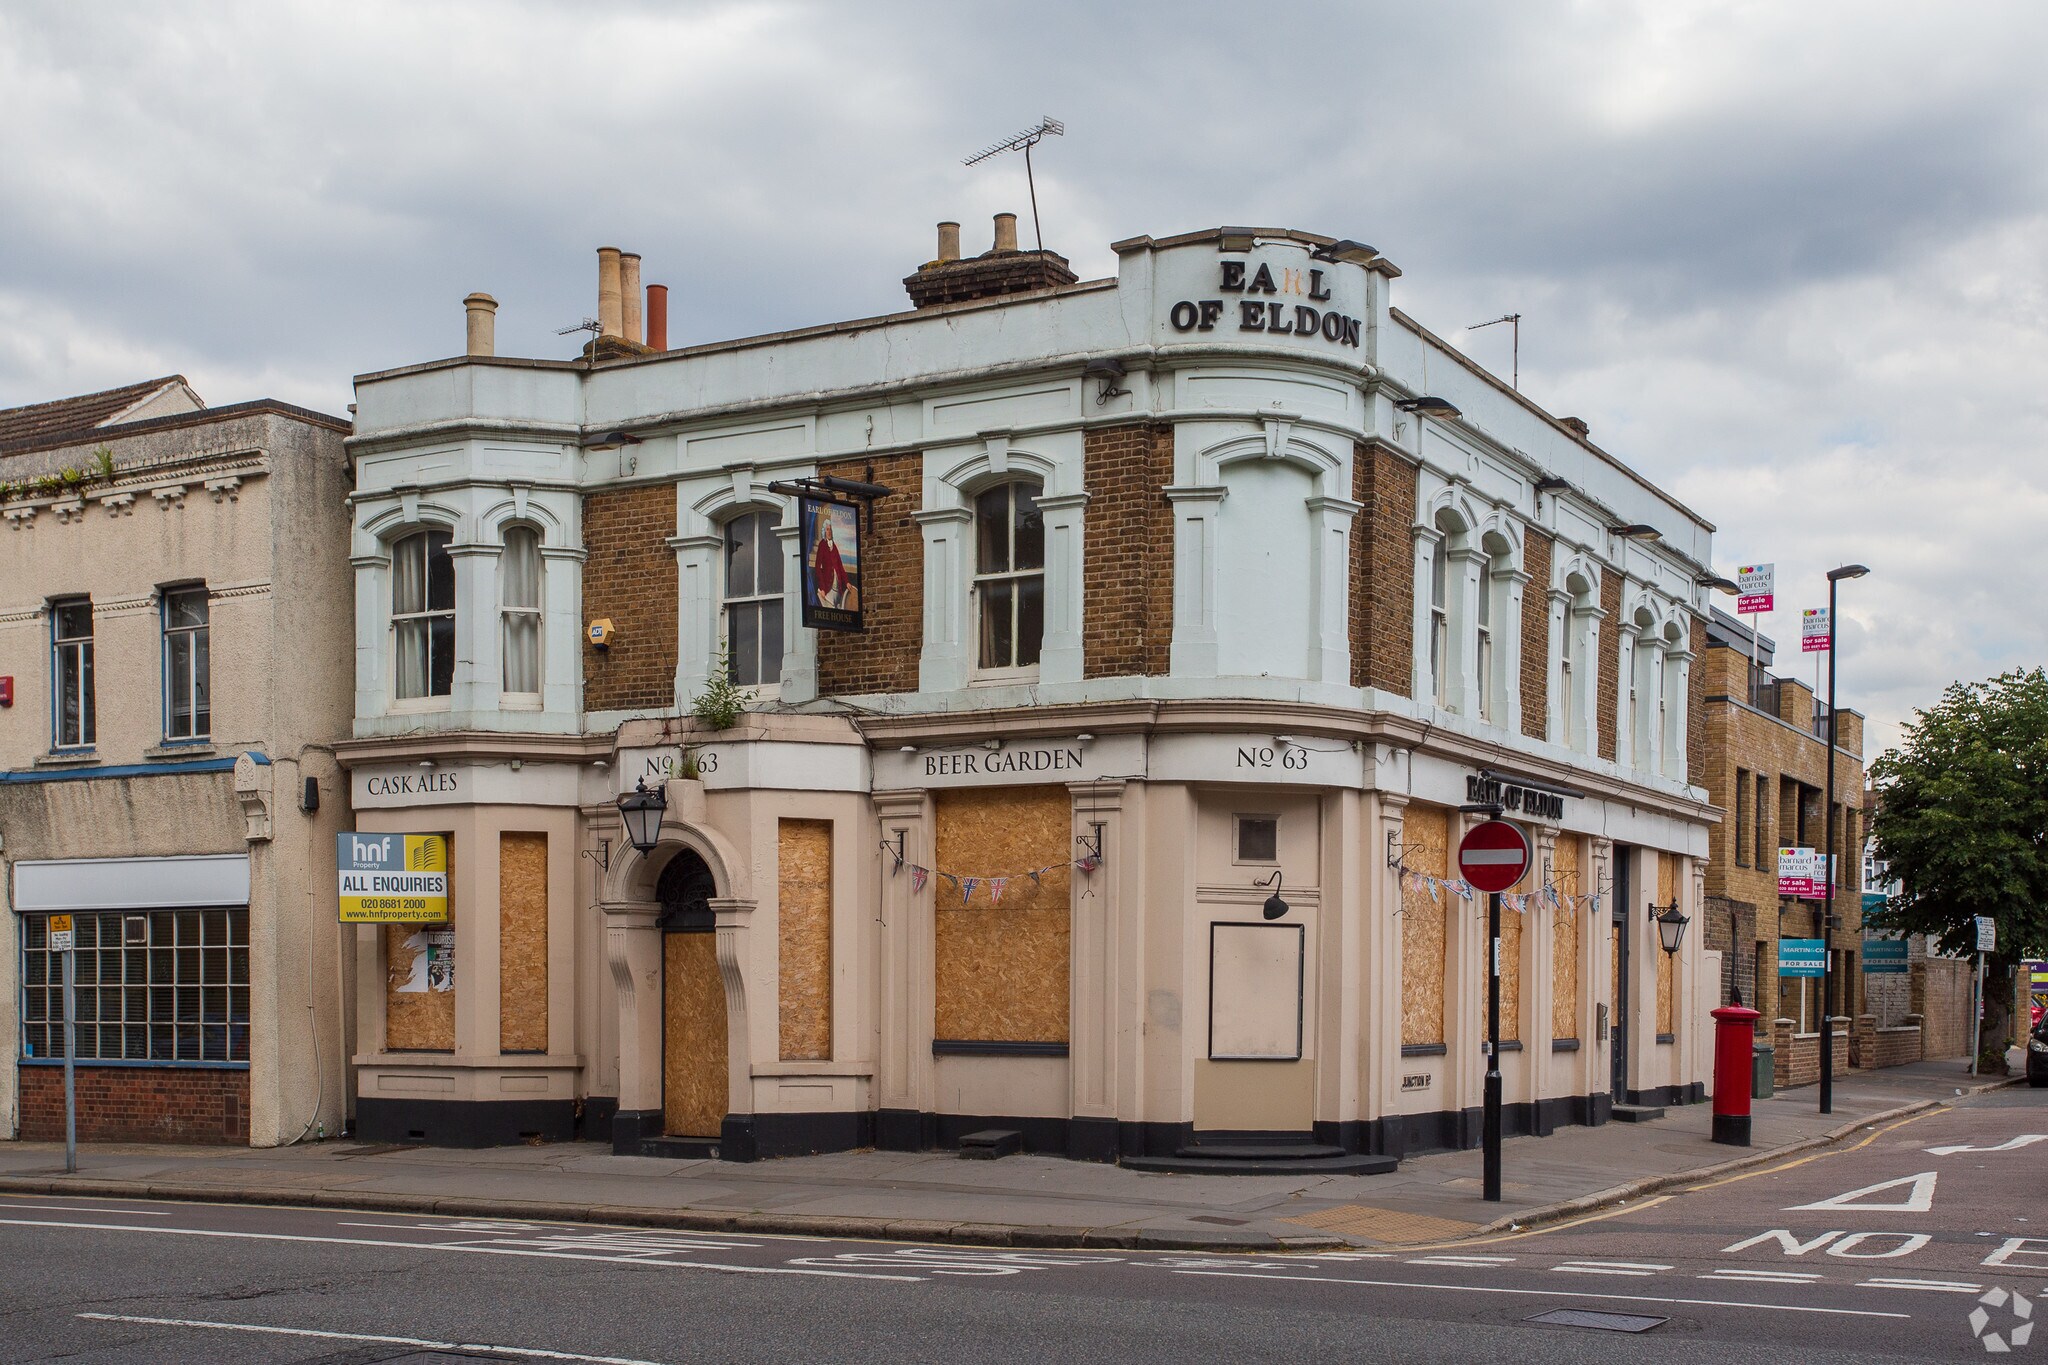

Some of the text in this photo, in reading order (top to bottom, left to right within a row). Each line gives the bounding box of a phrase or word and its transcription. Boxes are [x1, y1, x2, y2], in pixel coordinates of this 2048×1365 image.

[1170, 299, 1362, 348] OF ELDON
[807, 504, 823, 515] EARL
[1739, 572, 1771, 583] barnard
[1739, 581, 1768, 590] marcus
[814, 610, 852, 623] FREE HOUSE
[592, 628, 602, 636] ADT
[697, 752, 718, 773] 63
[925, 748, 1084, 775] BEER GARDEN
[1282, 749, 1308, 770] 63
[367, 773, 457, 795] CASK ALES
[1504, 785, 1523, 811] OF
[1523, 788, 1564, 819] ELDON
[352, 835, 391, 862] hnf
[353, 861, 380, 870] Property
[1779, 856, 1812, 864] barnard
[343, 876, 443, 892] ALL ENQUIRIES
[361, 899, 426, 909] 020 8681 2000
[346, 910, 441, 919] www.hnfproperty.com
[1720, 1229, 1933, 1259] NO
